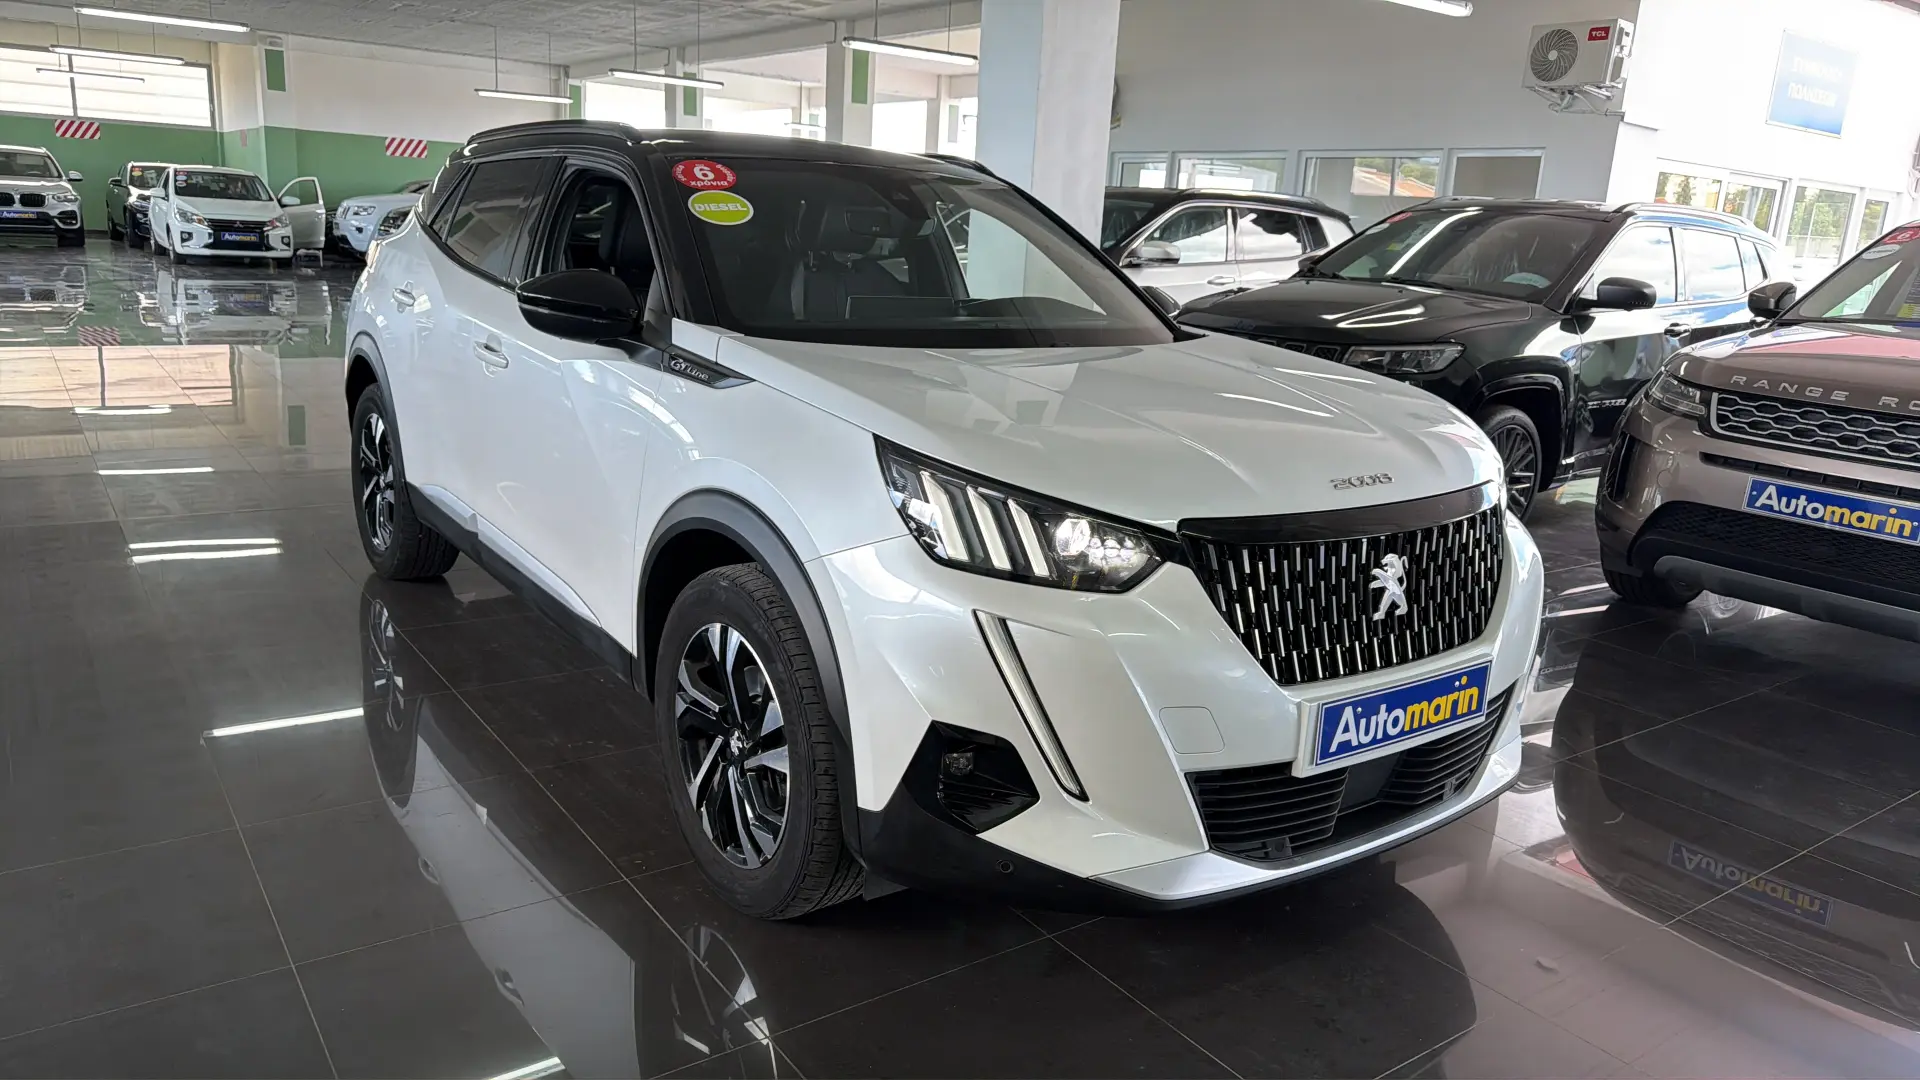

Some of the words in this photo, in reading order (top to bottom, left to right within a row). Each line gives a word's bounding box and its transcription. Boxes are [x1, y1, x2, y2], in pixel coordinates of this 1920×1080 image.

[693, 165, 715, 181] 6
[690, 179, 729, 188] χρόνια
[694, 203, 748, 212] DIESEL
[223, 232, 257, 241] Automarin
[687, 364, 709, 380] Line
[1730, 375, 1850, 401] RANGE
[1329, 473, 1395, 490] 2008
[1754, 484, 1913, 537] Automarin
[1329, 675, 1479, 753] Automarin
